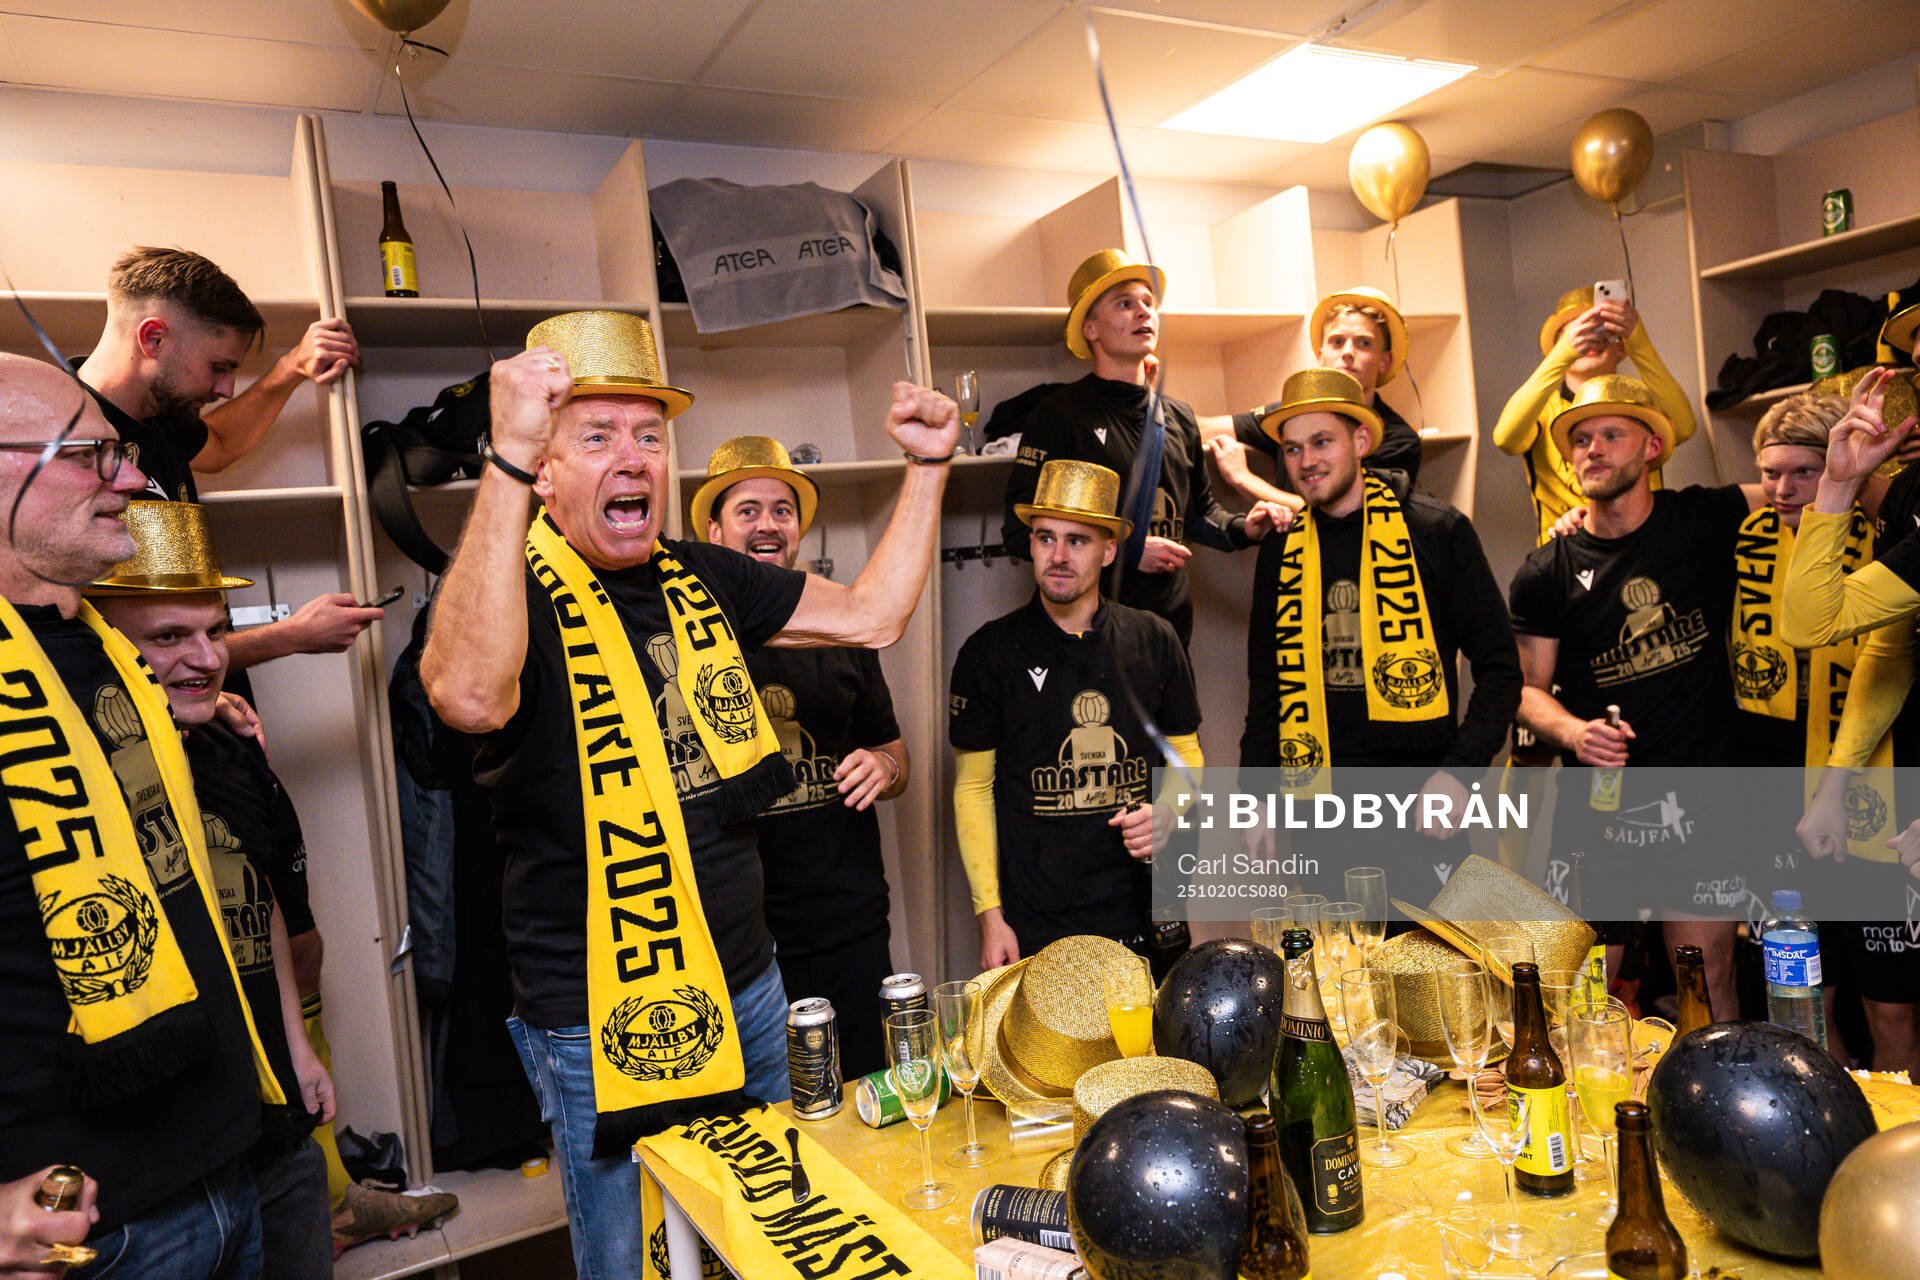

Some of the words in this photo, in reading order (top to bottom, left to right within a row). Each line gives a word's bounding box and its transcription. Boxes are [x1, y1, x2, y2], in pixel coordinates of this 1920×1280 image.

[714, 248, 776, 275] ATEA
[798, 236, 856, 260] ATEA
[1370, 538, 1424, 643] 2025
[1276, 546, 1310, 724] SVENSKA
[1080, 751, 1106, 760] SVENSKA
[1031, 757, 1148, 793] MÄSTARE
[1056, 793, 1074, 810] 20
[598, 811, 686, 984] 2025
[1693, 891, 1714, 906] on
[51, 922, 130, 958] MJÄLLBY
[1865, 938, 1887, 953] on
[81, 950, 124, 974] AIF
[627, 1025, 698, 1049] MJÄLLBY
[647, 1046, 682, 1060] AIF
